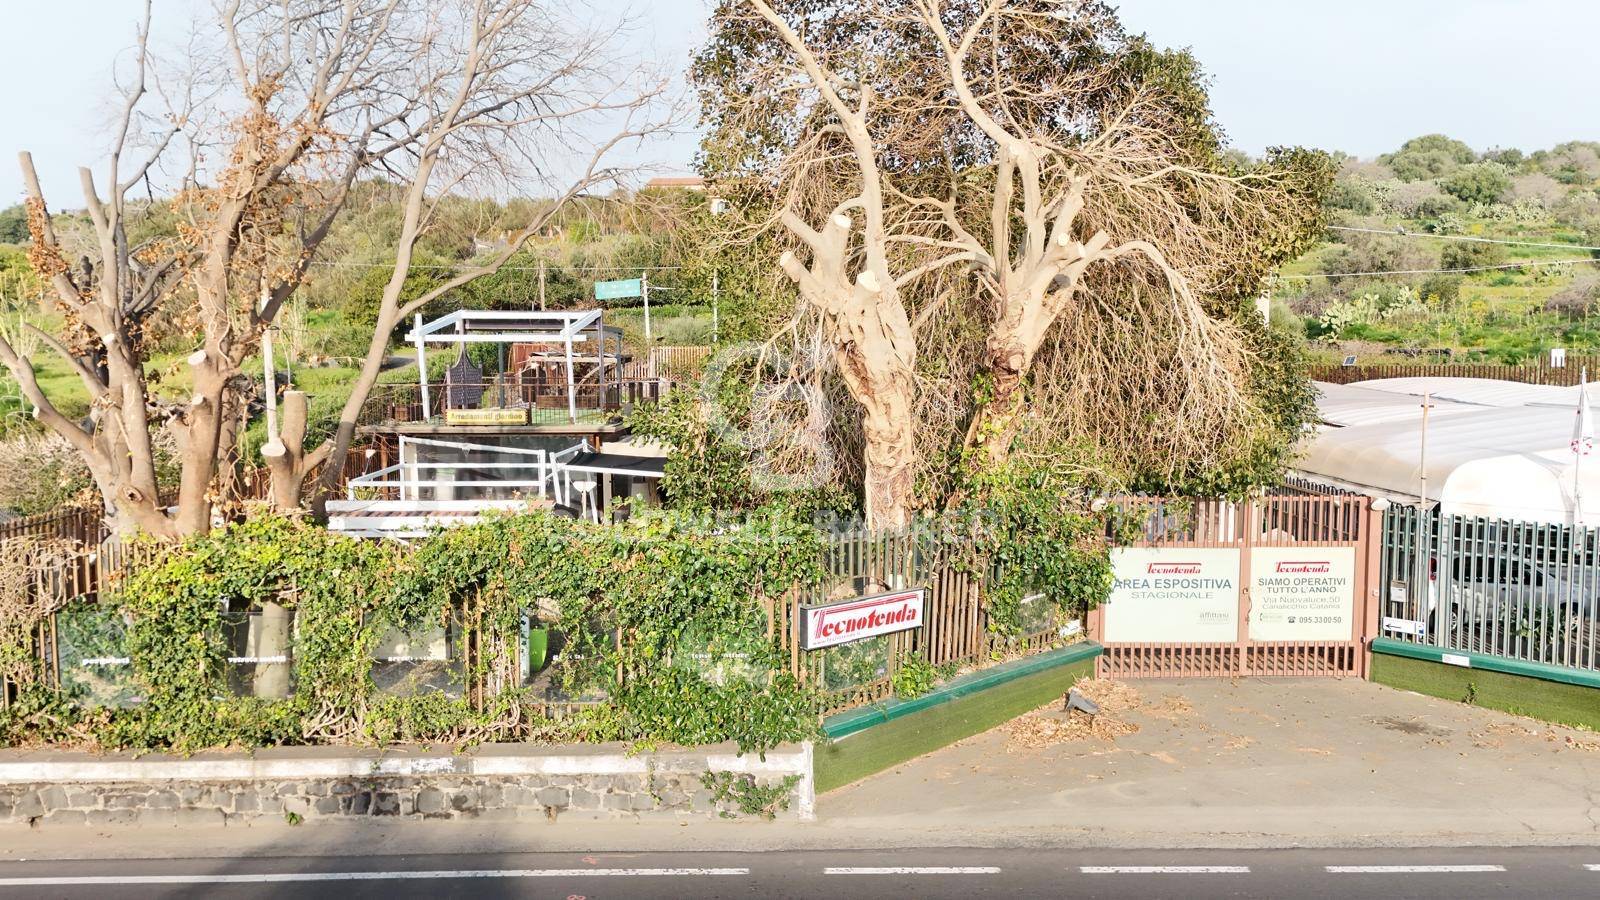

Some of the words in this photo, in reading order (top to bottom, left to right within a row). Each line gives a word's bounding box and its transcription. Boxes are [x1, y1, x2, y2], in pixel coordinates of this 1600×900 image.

[1146, 562, 1202, 574] Tecnotenda
[1275, 561, 1331, 573] Tecnotenda
[1113, 578, 1151, 589] AREA
[1154, 578, 1232, 589] ESPOSITIVA
[1258, 577, 1291, 586] SIAMO
[1293, 577, 1346, 586] OPERATIVI
[1130, 591, 1214, 599] STAGIONALE
[1267, 586, 1298, 594] TUTTO
[1300, 586, 1337, 594] L'ANNO
[1263, 596, 1277, 604] Via
[813, 593, 918, 639] Tecnotenda
